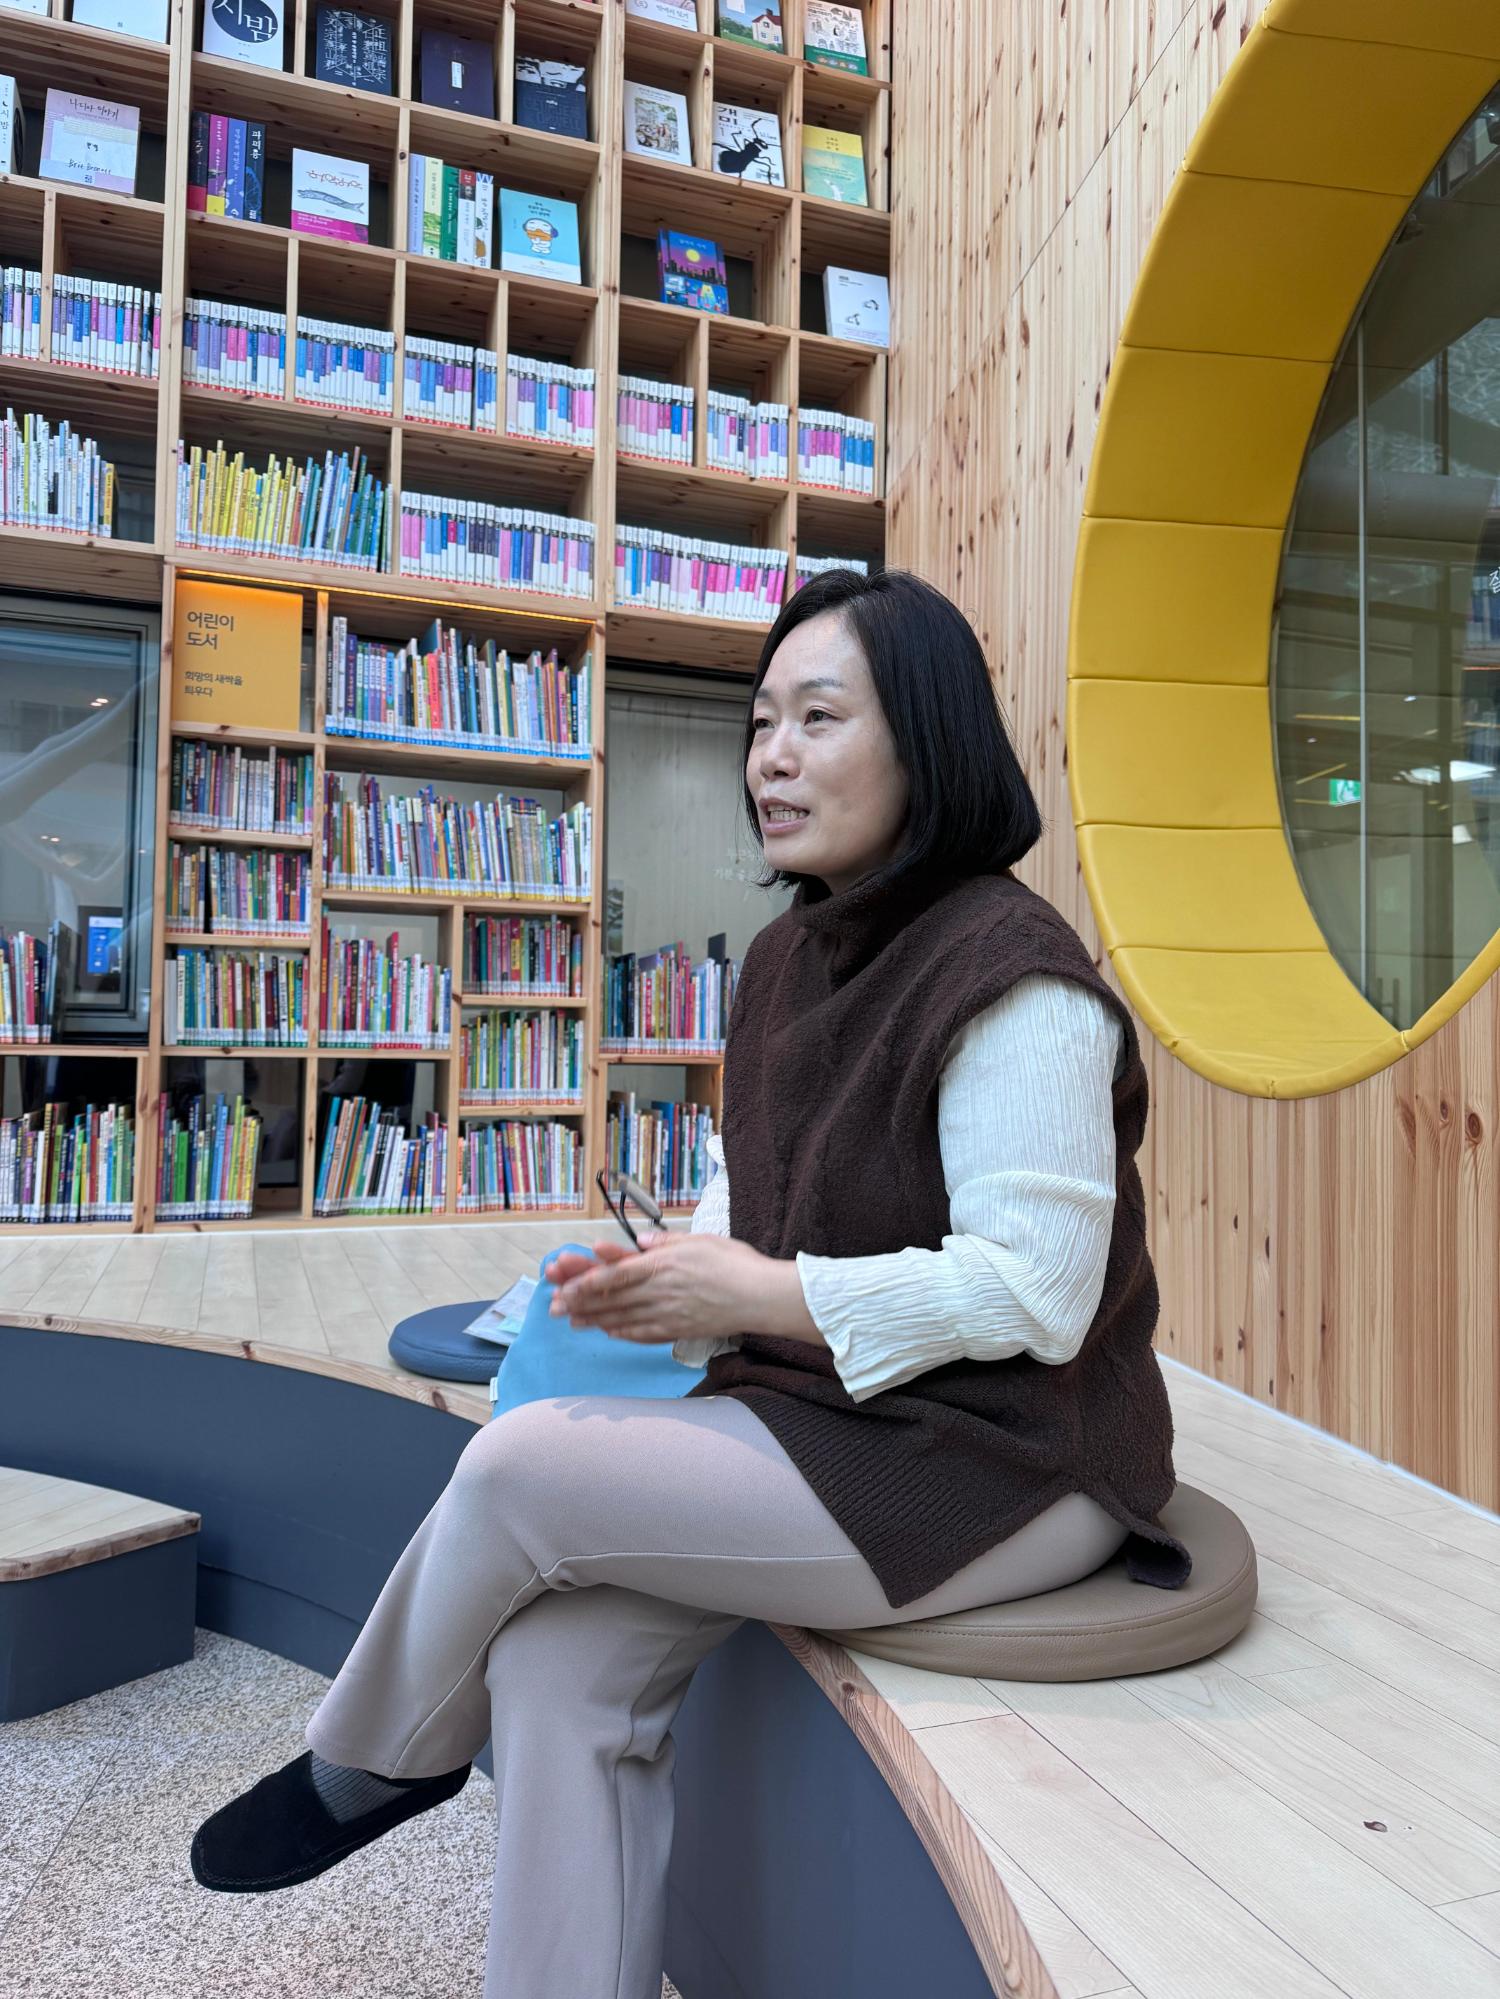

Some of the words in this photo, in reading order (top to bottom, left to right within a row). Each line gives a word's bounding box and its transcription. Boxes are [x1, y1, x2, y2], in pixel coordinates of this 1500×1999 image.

[250, 130, 262, 160] 파피용
[186, 611, 234, 632] 어린이
[185, 632, 218, 650] 도서
[184, 671, 213, 683] 희망의
[215, 673, 243, 686] 새싹을
